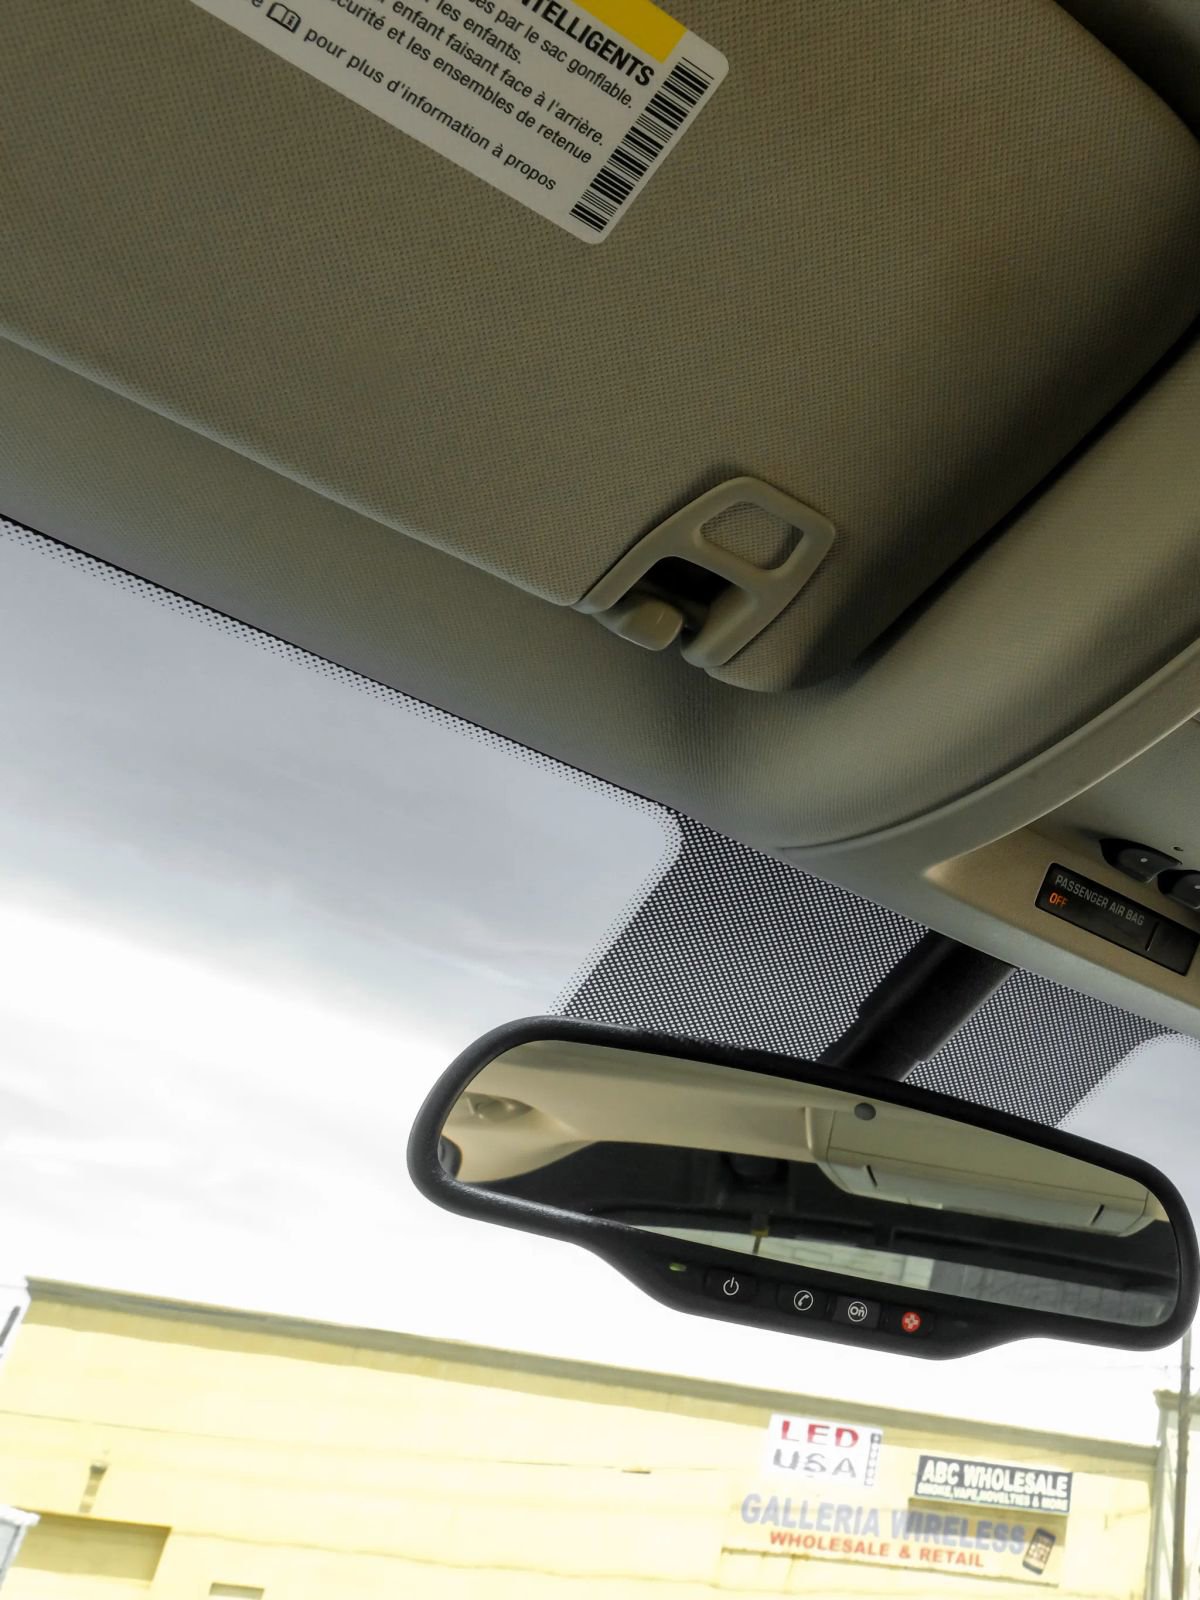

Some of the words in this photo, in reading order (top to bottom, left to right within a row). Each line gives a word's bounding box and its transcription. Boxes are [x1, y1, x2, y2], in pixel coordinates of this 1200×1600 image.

[436, 0, 462, 22] les
[463, 18, 521, 64] enfants.
[494, 9, 525, 32] par
[524, 25, 540, 44] le
[541, 38, 566, 64] sac
[567, 57, 632, 109] gonflable.
[331, 0, 387, 30] curité
[387, 26, 406, 45] et
[406, 36, 432, 62] les
[433, 52, 514, 115] ensembles
[516, 109, 535, 129] de
[536, 123, 593, 165] retenue
[392, 0, 445, 41] enfant
[445, 33, 500, 76] faisant
[497, 69, 534, 98] face
[534, 91, 546, 107] à
[548, 99, 605, 147] l'arrière.
[304, 28, 347, 59] pour
[346, 55, 385, 84] plus
[386, 78, 490, 151] d'information
[491, 143, 504, 159] à
[503, 153, 557, 191] propos
[1049, 892, 1068, 907] OFF
[1055, 874, 1109, 909] PASSENGER
[1108, 901, 1126, 917] AIR
[1125, 909, 1145, 926] BAG
[780, 1419, 860, 1449] LED
[772, 1448, 857, 1478] USA
[922, 1459, 960, 1486] ABC
[963, 1463, 1069, 1498] WHOLESALE
[740, 1493, 881, 1538] GALLERIA
[890, 1508, 1026, 1556] WIRELESS
[770, 1530, 891, 1559] WHOLESALE
[898, 1544, 912, 1560] &
[919, 1547, 985, 1568] RETAIL
